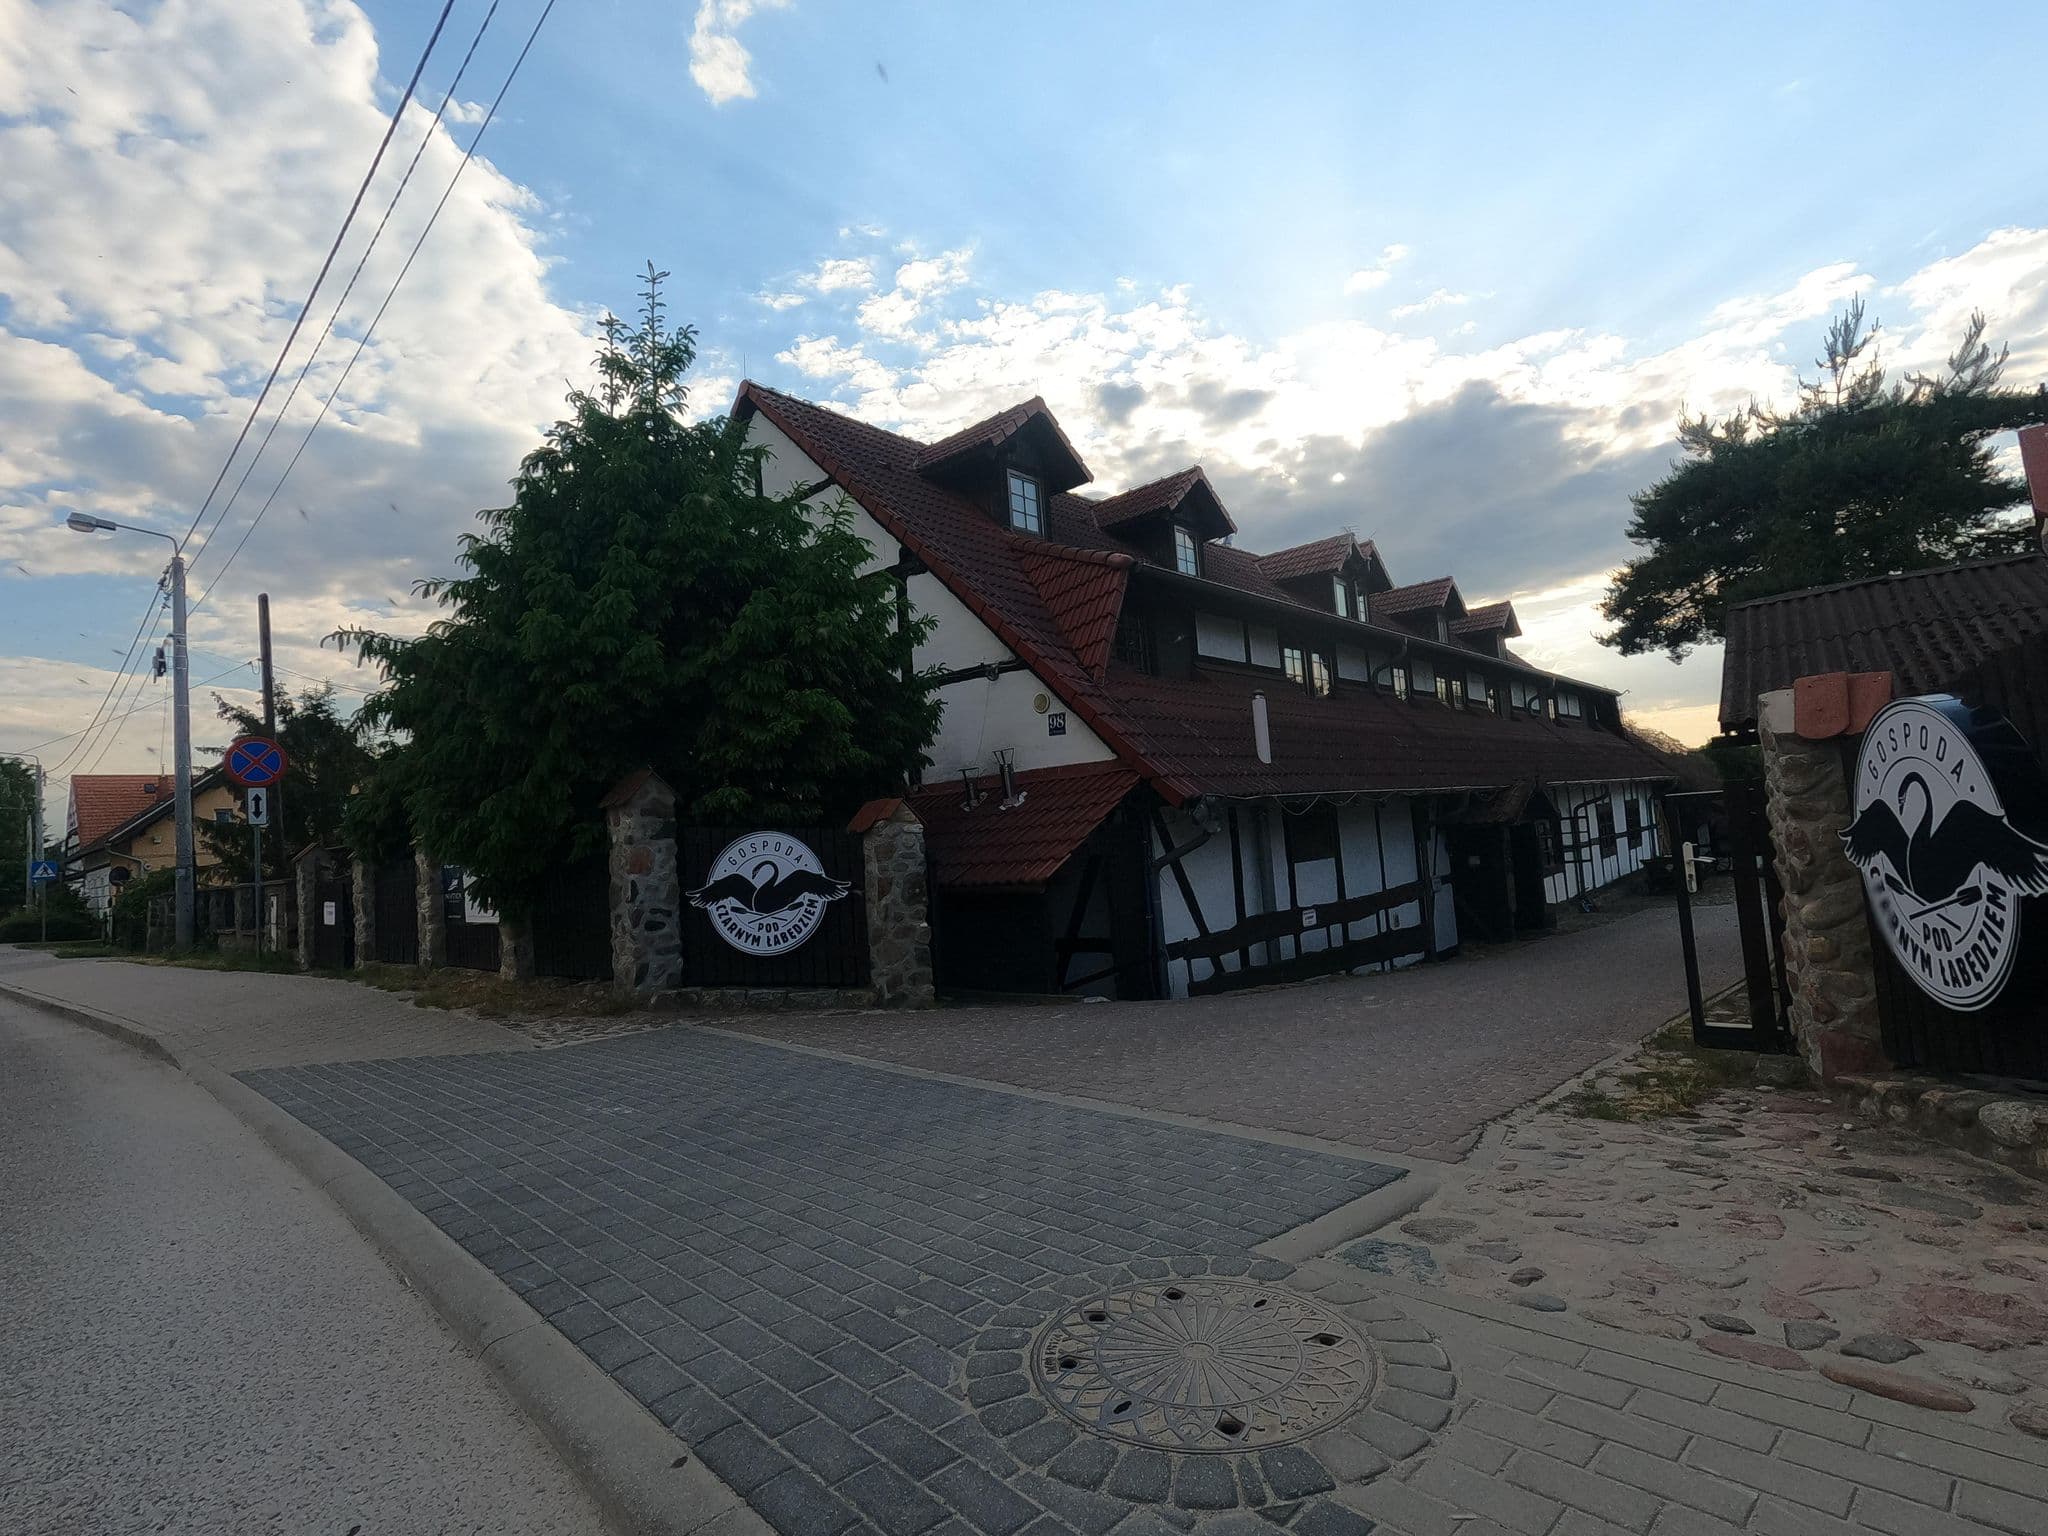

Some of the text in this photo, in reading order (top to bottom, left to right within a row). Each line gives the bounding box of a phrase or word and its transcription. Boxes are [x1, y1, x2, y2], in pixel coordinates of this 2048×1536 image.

[1050, 714, 1064, 729] 98
[1868, 722, 1965, 783] GOSPODA
[728, 840, 805, 866] GOSPODA
[716, 898, 819, 947] CZARNYM ŁABĘDZIEM
[758, 922, 779, 933] POD
[1922, 922, 1953, 953] POD
[1938, 881, 2007, 988] ŁABĘDZIEM
